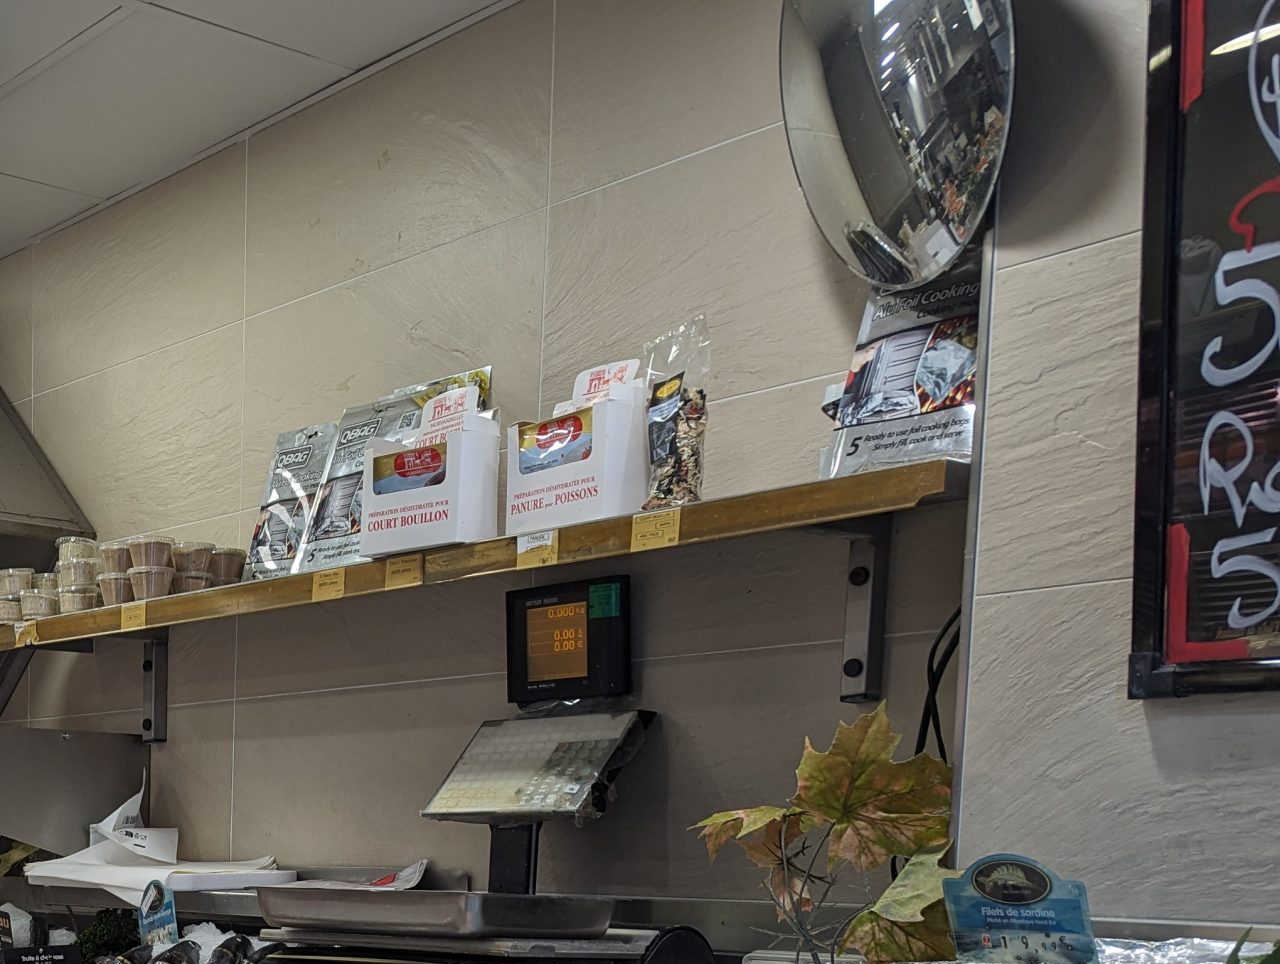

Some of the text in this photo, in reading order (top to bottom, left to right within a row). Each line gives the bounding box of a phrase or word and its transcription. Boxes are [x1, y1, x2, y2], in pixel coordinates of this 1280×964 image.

[922, 282, 979, 303] Cooking
[341, 424, 377, 443] QBAG
[846, 436, 863, 456] 5
[864, 432, 885, 442] Ready
[887, 430, 895, 438] to
[908, 425, 922, 436] foil
[922, 421, 949, 433] cooking
[950, 417, 969, 428] bags
[873, 440, 897, 452] Simply
[909, 435, 927, 444] cook
[928, 433, 943, 442] and
[944, 430, 964, 439] serve
[277, 451, 310, 467] QBAG
[514, 476, 595, 500] PRÉPARATION DÉSHYDRATÉE POUR
[511, 499, 544, 515] PANURE
[555, 485, 598, 505] POISSONS
[368, 508, 399, 518] PRÉPARATION
[400, 502, 433, 513] DÉSHYDRATÉE
[368, 509, 449, 532] COURT BOUILLON
[307, 549, 317, 563] 5
[548, 606, 575, 619] 0.000
[554, 629, 575, 641] 0.00
[554, 641, 575, 652] 0.00
[981, 906, 1055, 917] Filets de sardine
